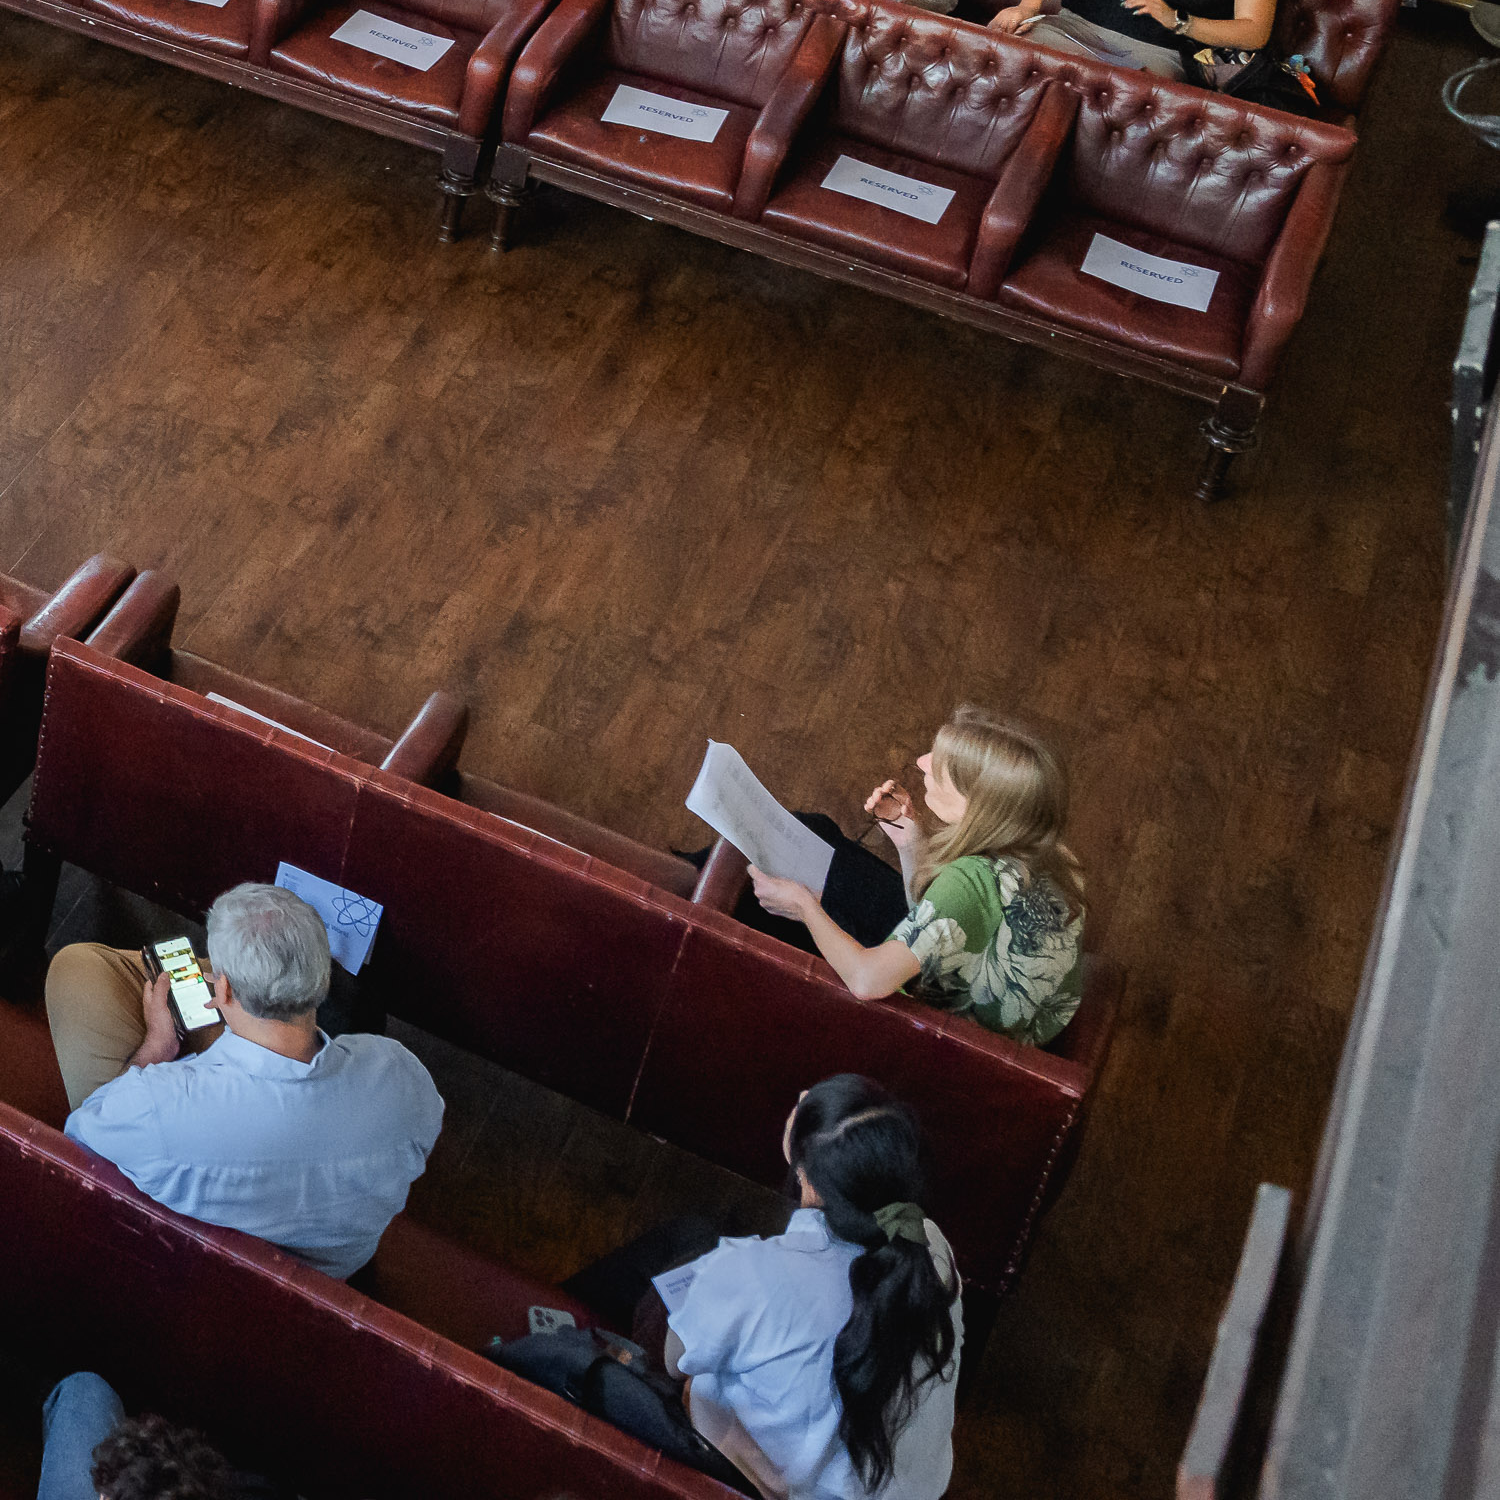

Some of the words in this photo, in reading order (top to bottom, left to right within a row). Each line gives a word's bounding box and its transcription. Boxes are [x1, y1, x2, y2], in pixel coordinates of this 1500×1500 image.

[369, 29, 418, 51] RESERVED
[639, 104, 694, 123] RESERVED
[860, 178, 919, 201] RESERVED
[1120, 261, 1183, 285] RESERVED
